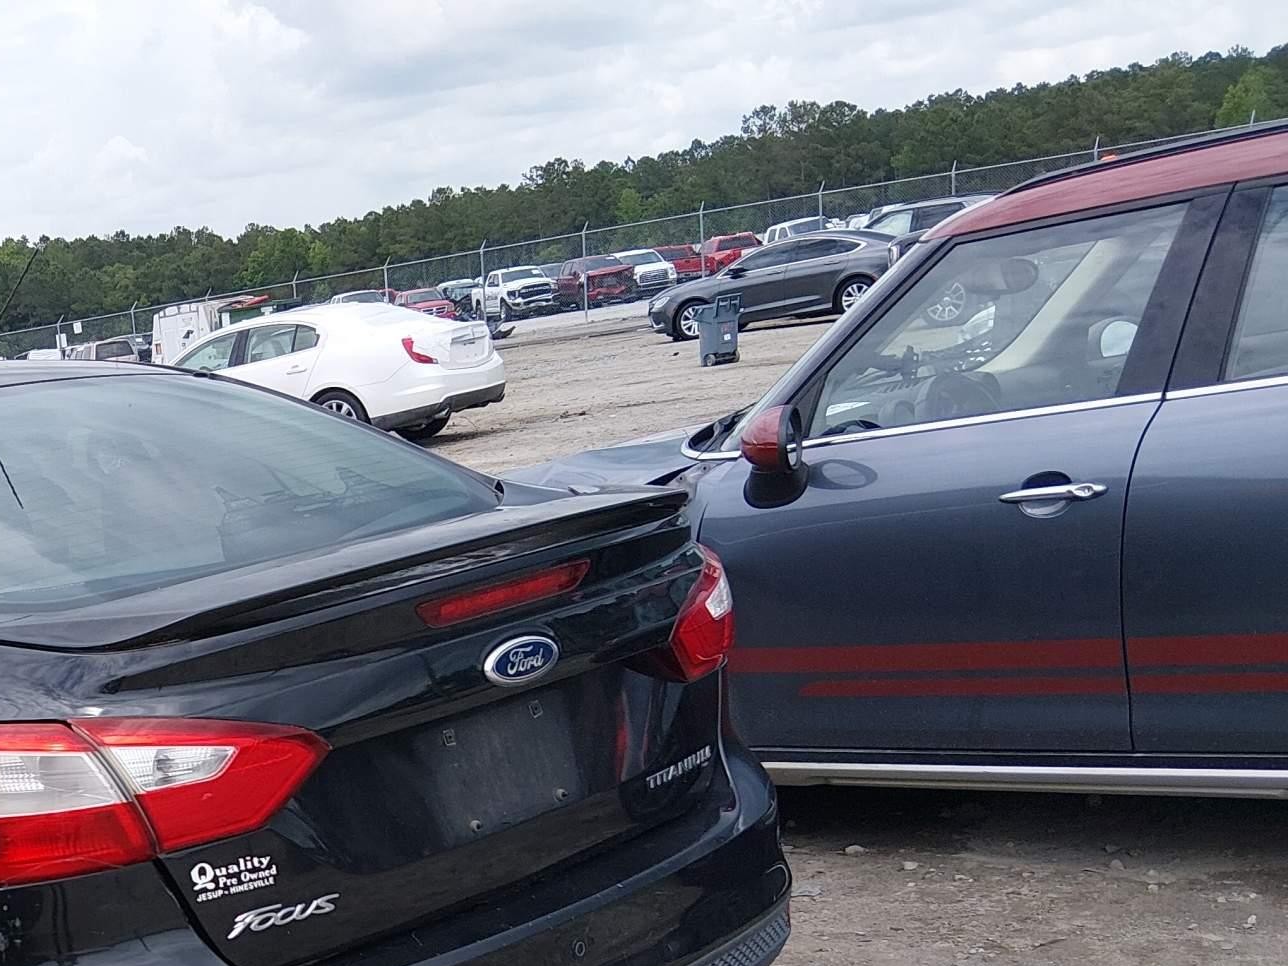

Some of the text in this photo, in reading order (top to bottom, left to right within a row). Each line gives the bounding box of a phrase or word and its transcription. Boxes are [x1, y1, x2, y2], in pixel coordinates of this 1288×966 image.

[507, 645, 544, 675] Ford
[646, 745, 711, 789] TITANIUM
[190, 855, 271, 891] Quality
[218, 864, 277, 888] Pre Owned
